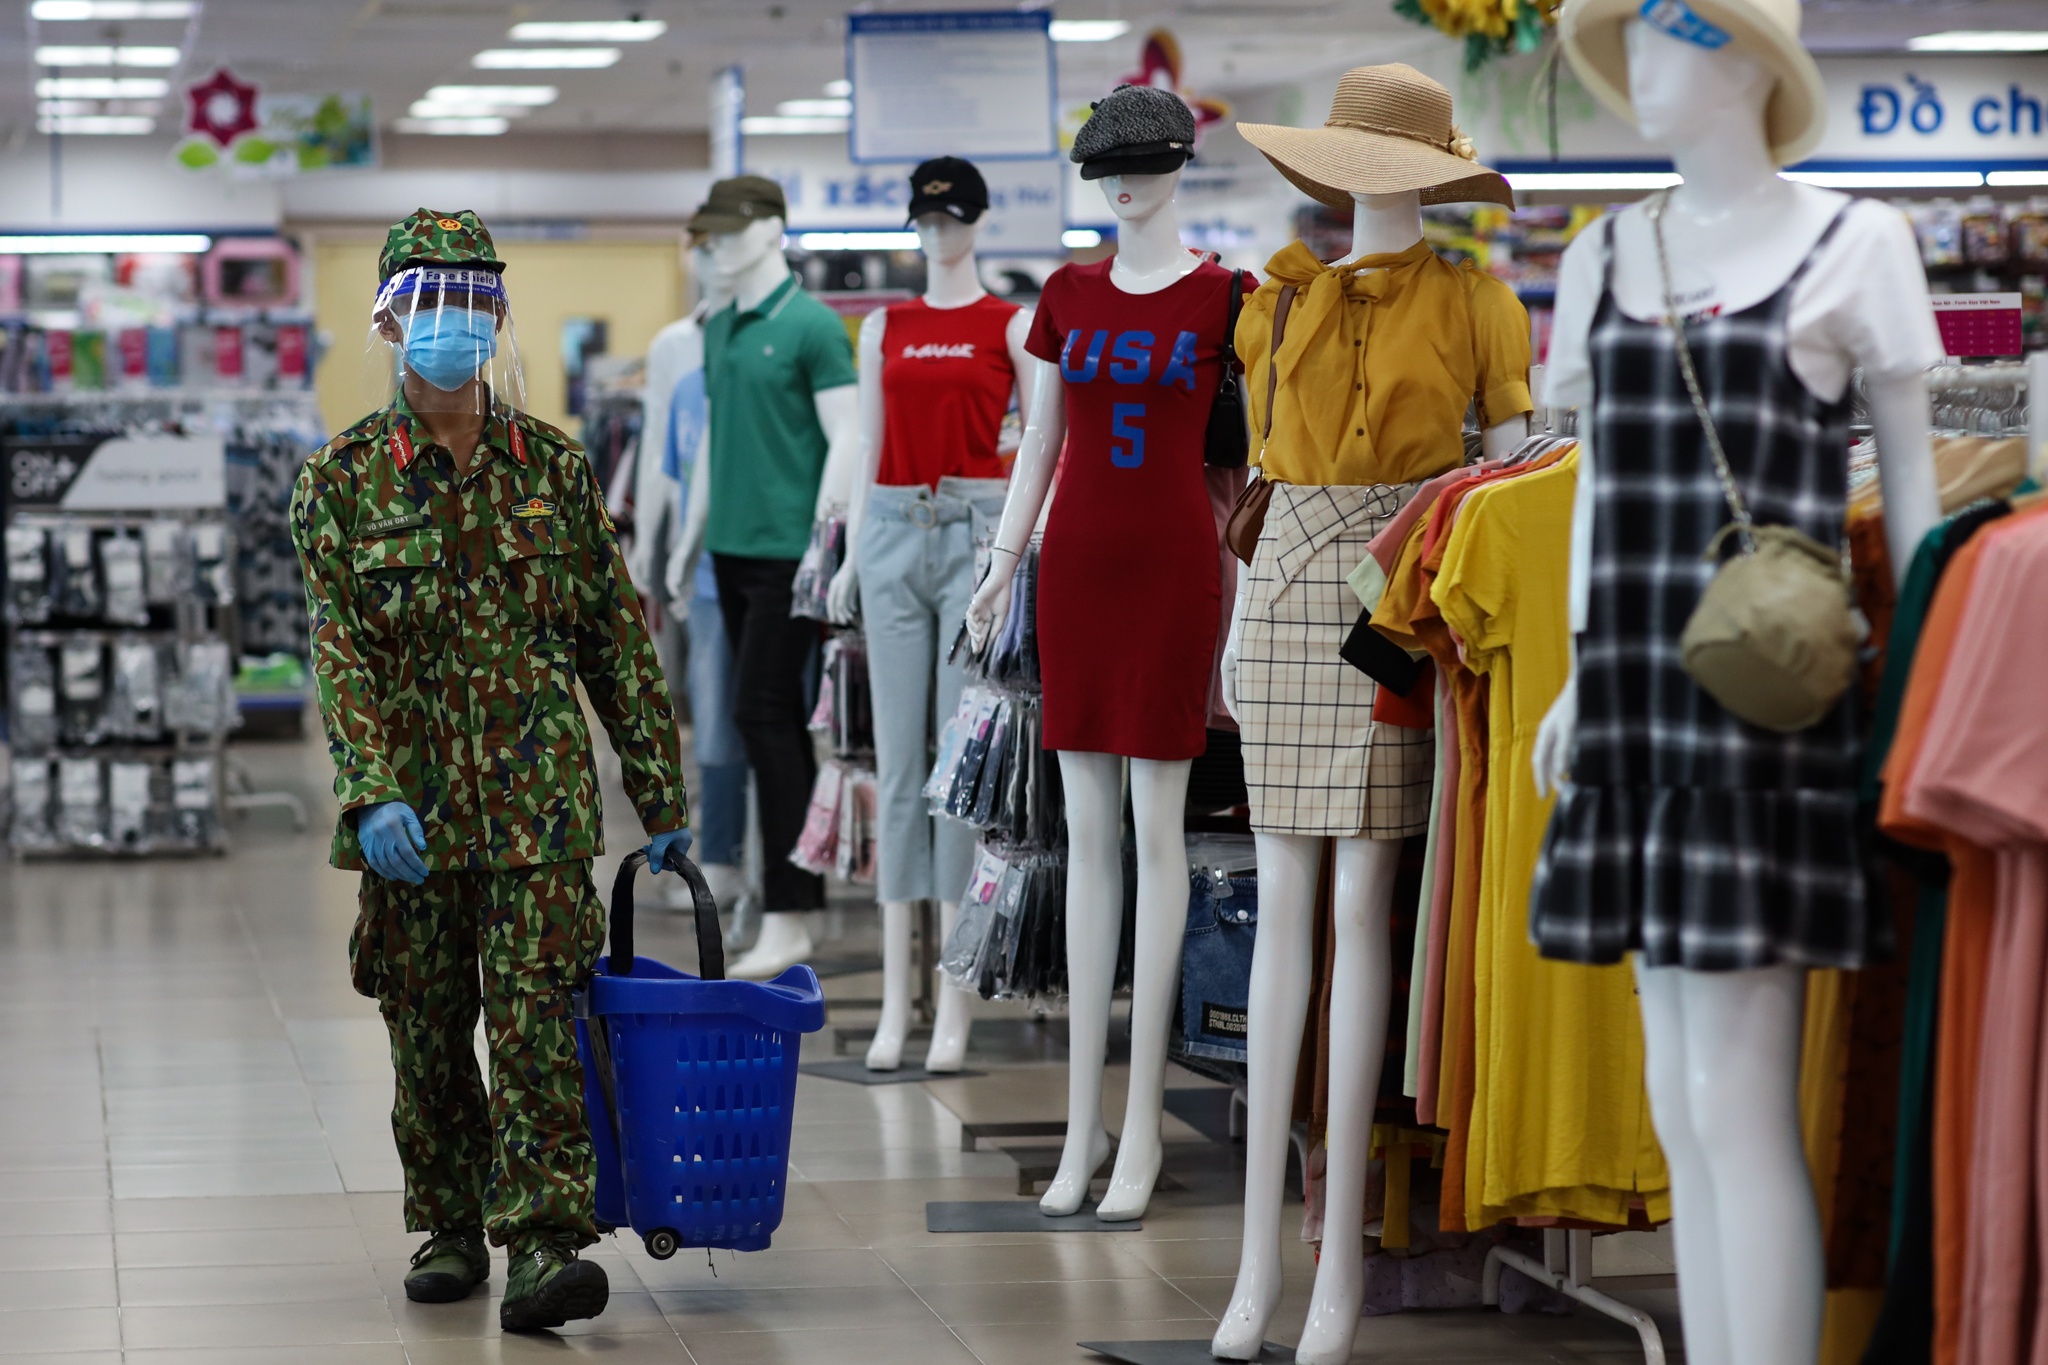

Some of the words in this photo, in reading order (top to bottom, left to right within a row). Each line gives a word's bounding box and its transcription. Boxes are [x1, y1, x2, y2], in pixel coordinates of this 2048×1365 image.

[1858, 72, 1943, 135] Đồ
[1972, 83, 2048, 135] ch
[1059, 329, 1198, 390] USA
[1111, 403, 1146, 469] 5
[378, 519, 393, 528] VĂN
